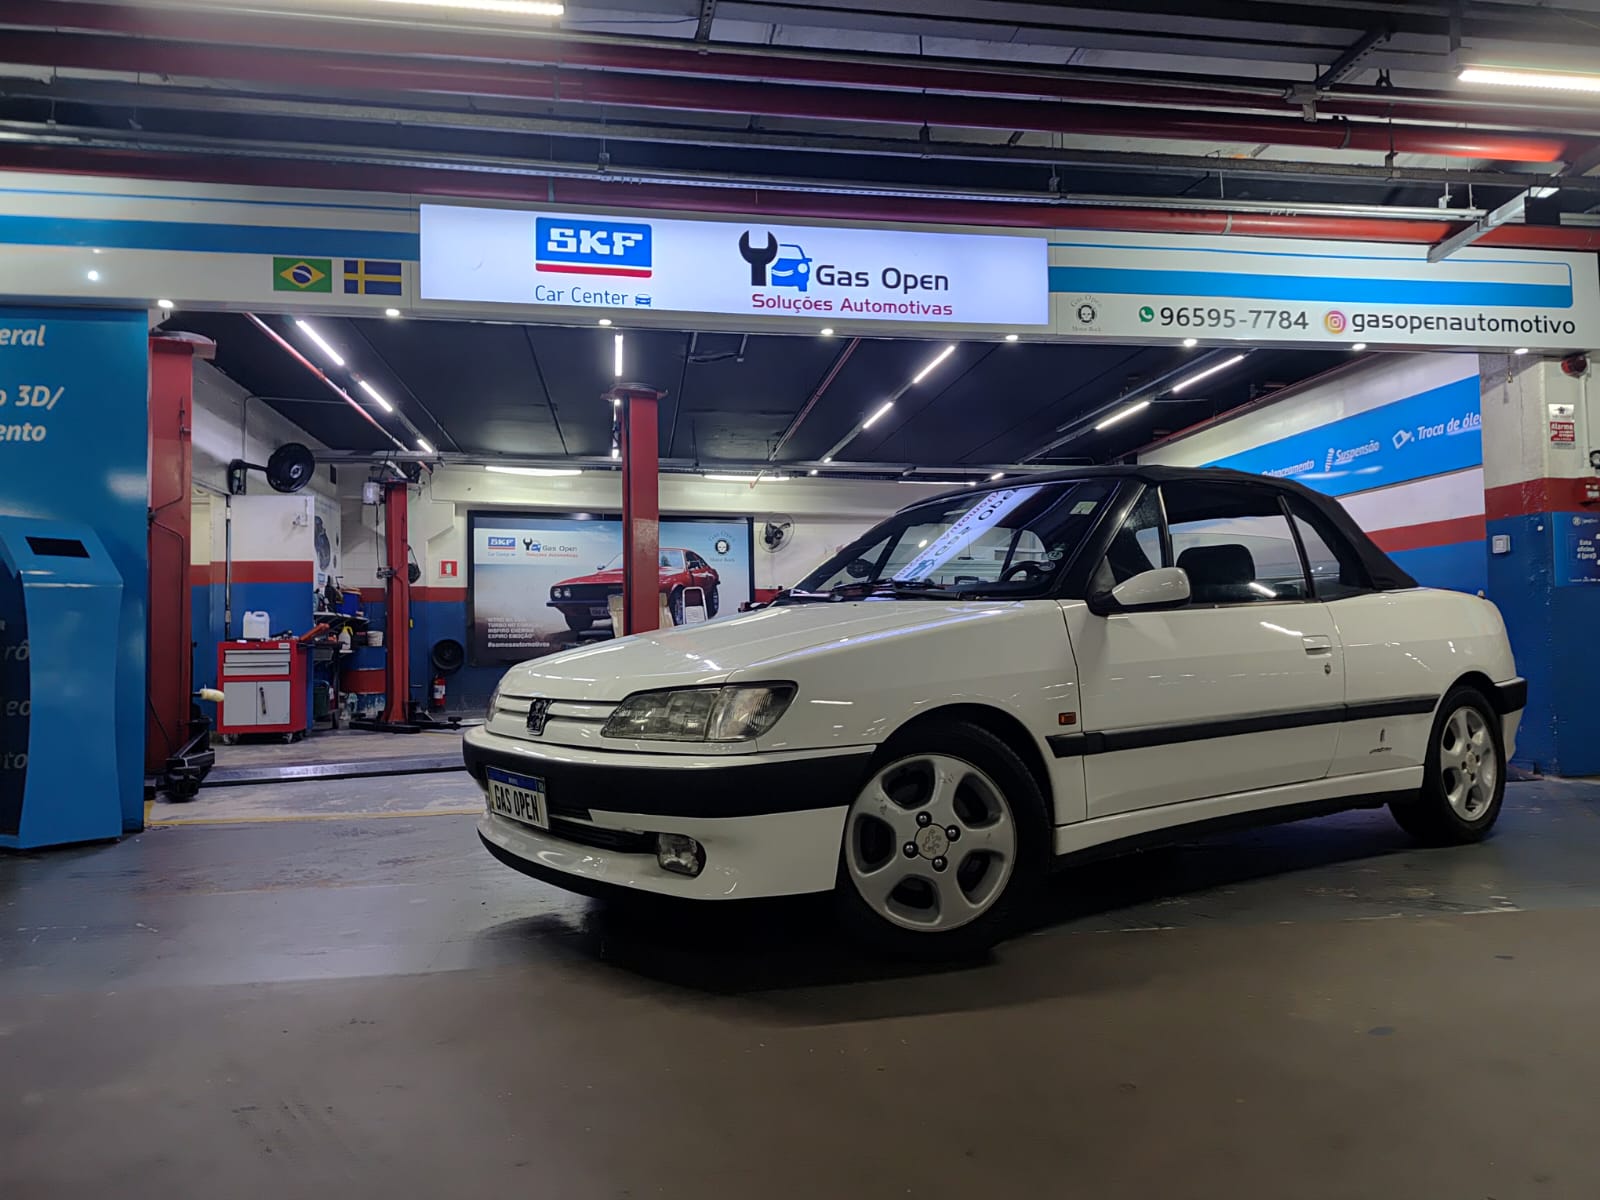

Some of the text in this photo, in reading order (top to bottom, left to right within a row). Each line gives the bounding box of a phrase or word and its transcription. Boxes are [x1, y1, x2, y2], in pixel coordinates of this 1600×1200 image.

[547, 228, 643, 256] SKF
[816, 265, 949, 294] Gas Open
[535, 284, 628, 305] Car Center
[752, 293, 953, 316] Soluções Automotivas
[1160, 307, 1309, 330] 96595-7784
[1352, 313, 1576, 335] gasopenautomotivo
[1417, 423, 1444, 440] Troca
[1447, 417, 1460, 432] de
[1336, 440, 1380, 463] Suspensão
[494, 784, 540, 822] GAS OPEN
